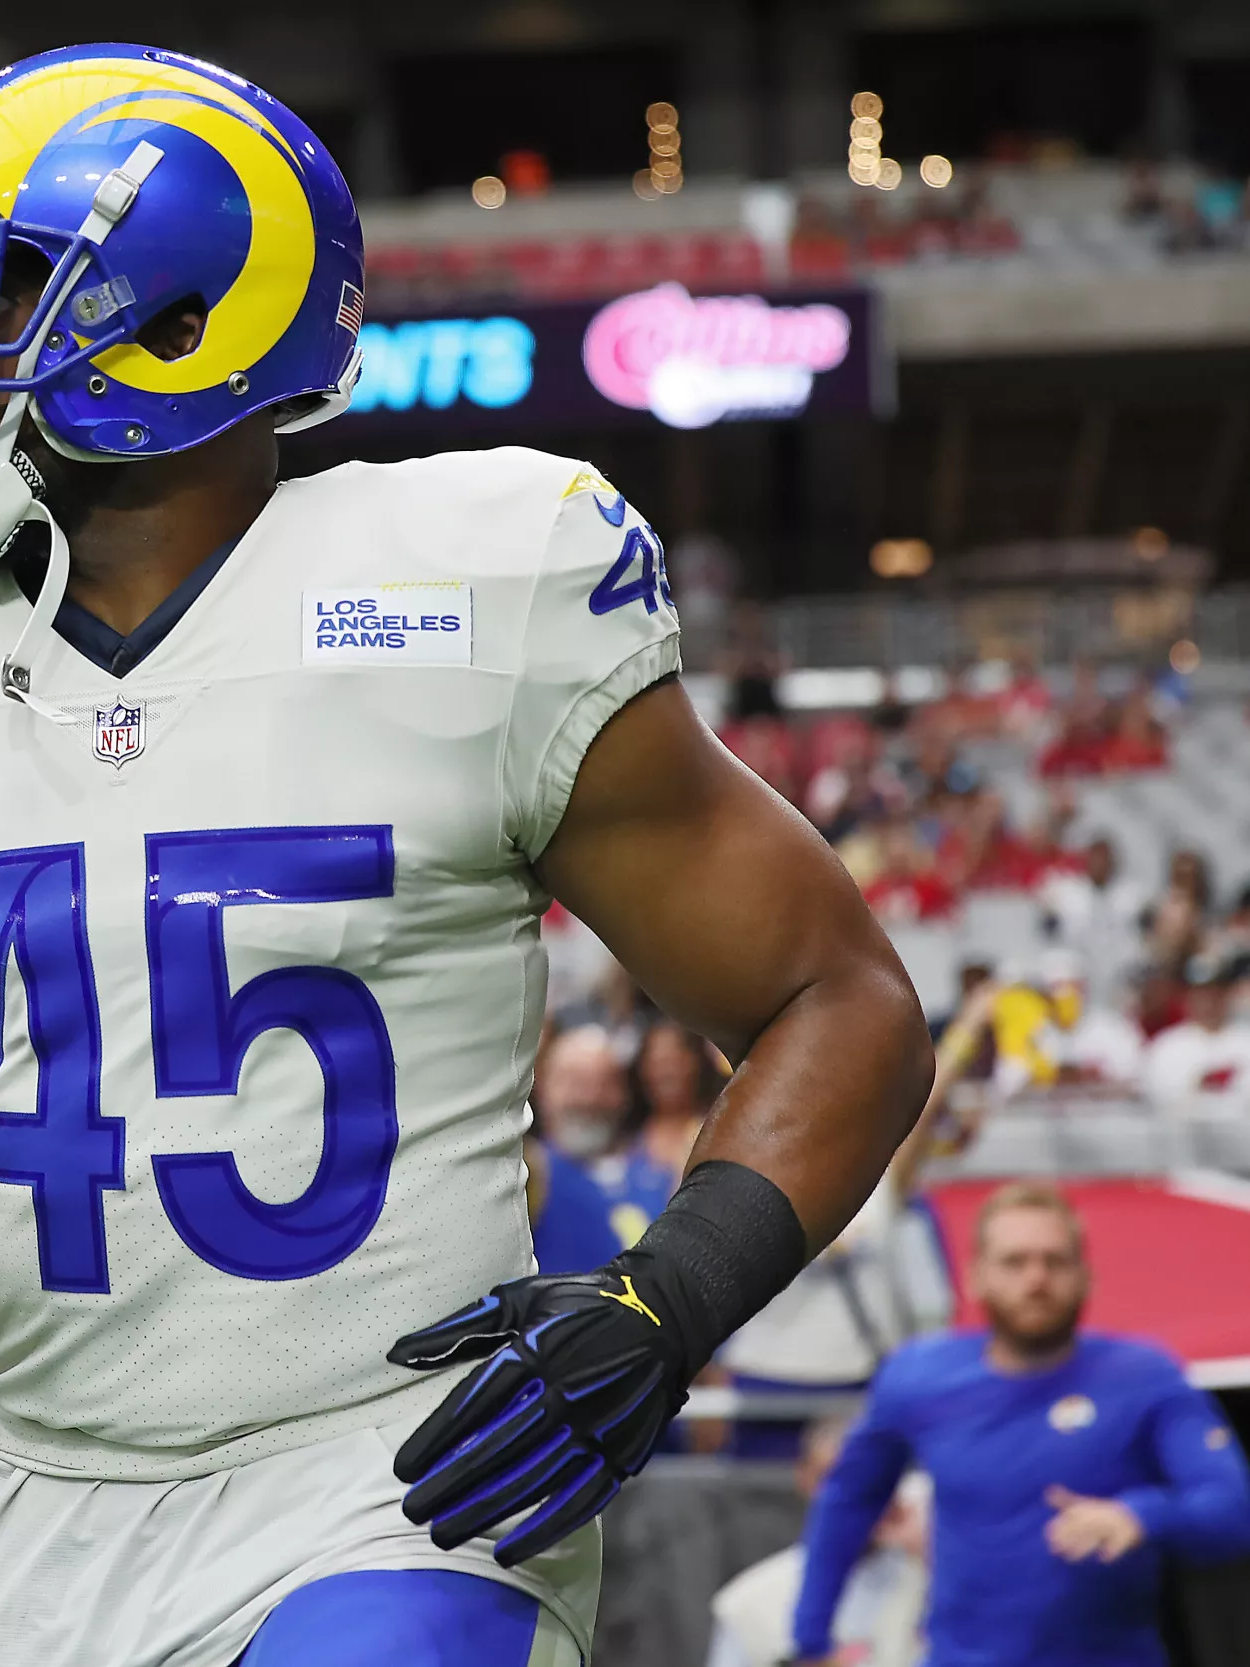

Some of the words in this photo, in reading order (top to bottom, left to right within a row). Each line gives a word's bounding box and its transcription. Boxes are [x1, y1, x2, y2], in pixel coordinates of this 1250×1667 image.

[317, 599, 377, 616] LOS
[316, 615, 461, 632] ANGELES
[316, 632, 406, 649] RAMS
[101, 727, 136, 754] NFL
